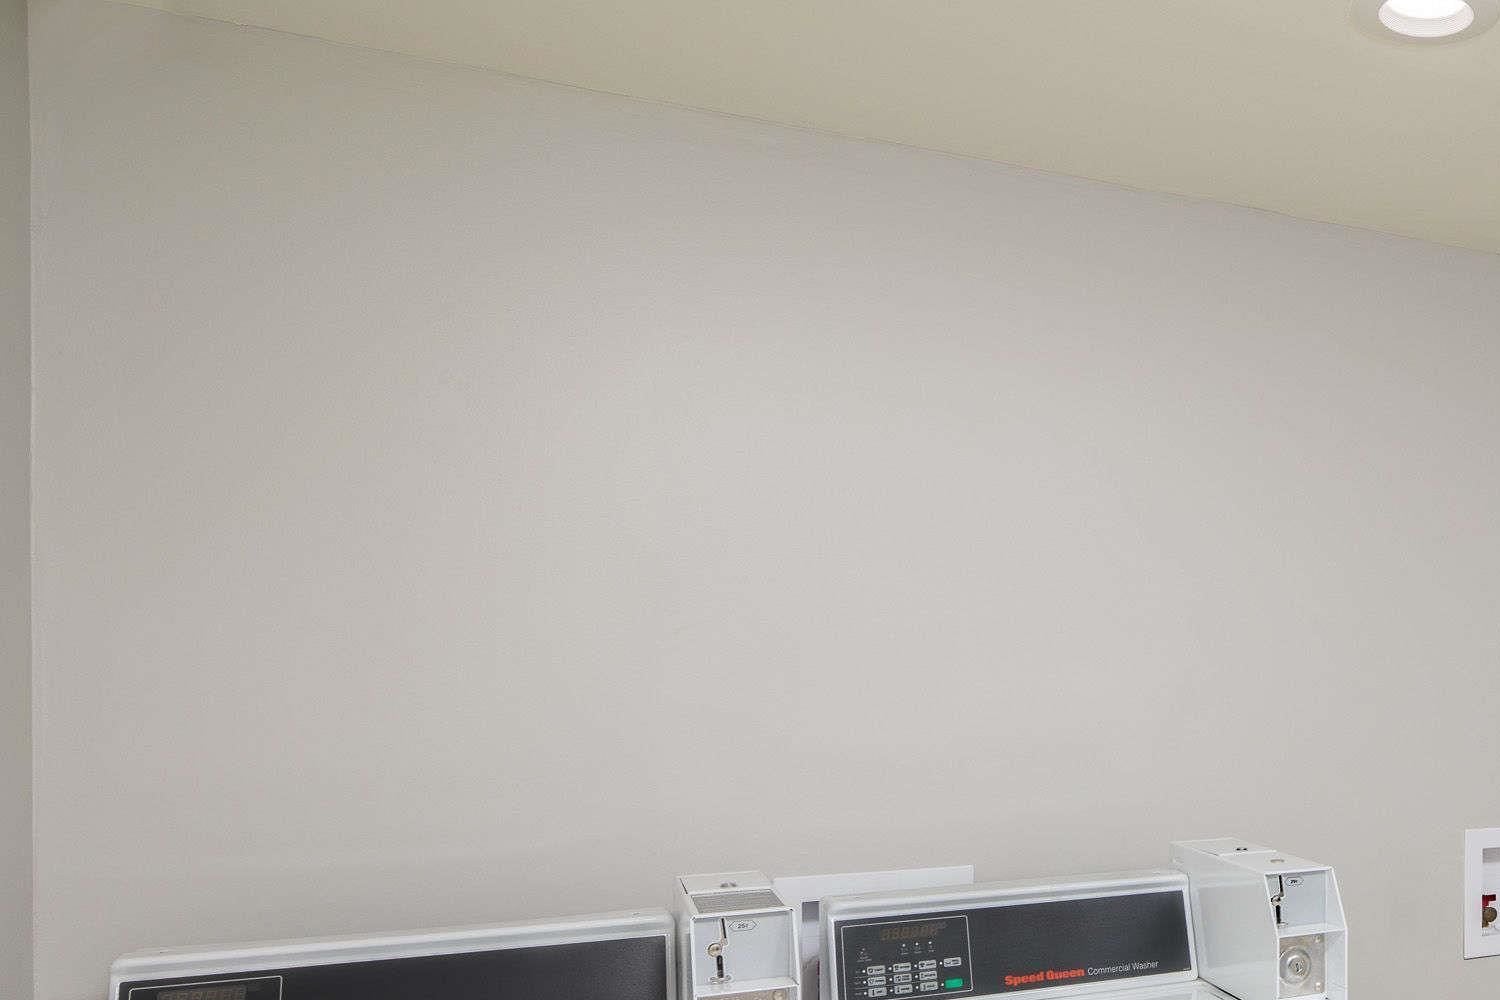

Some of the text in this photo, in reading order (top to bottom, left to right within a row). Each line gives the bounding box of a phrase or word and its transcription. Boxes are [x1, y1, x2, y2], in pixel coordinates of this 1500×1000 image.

[1004, 960, 1159, 986] Speed Queen Commercial Washer
